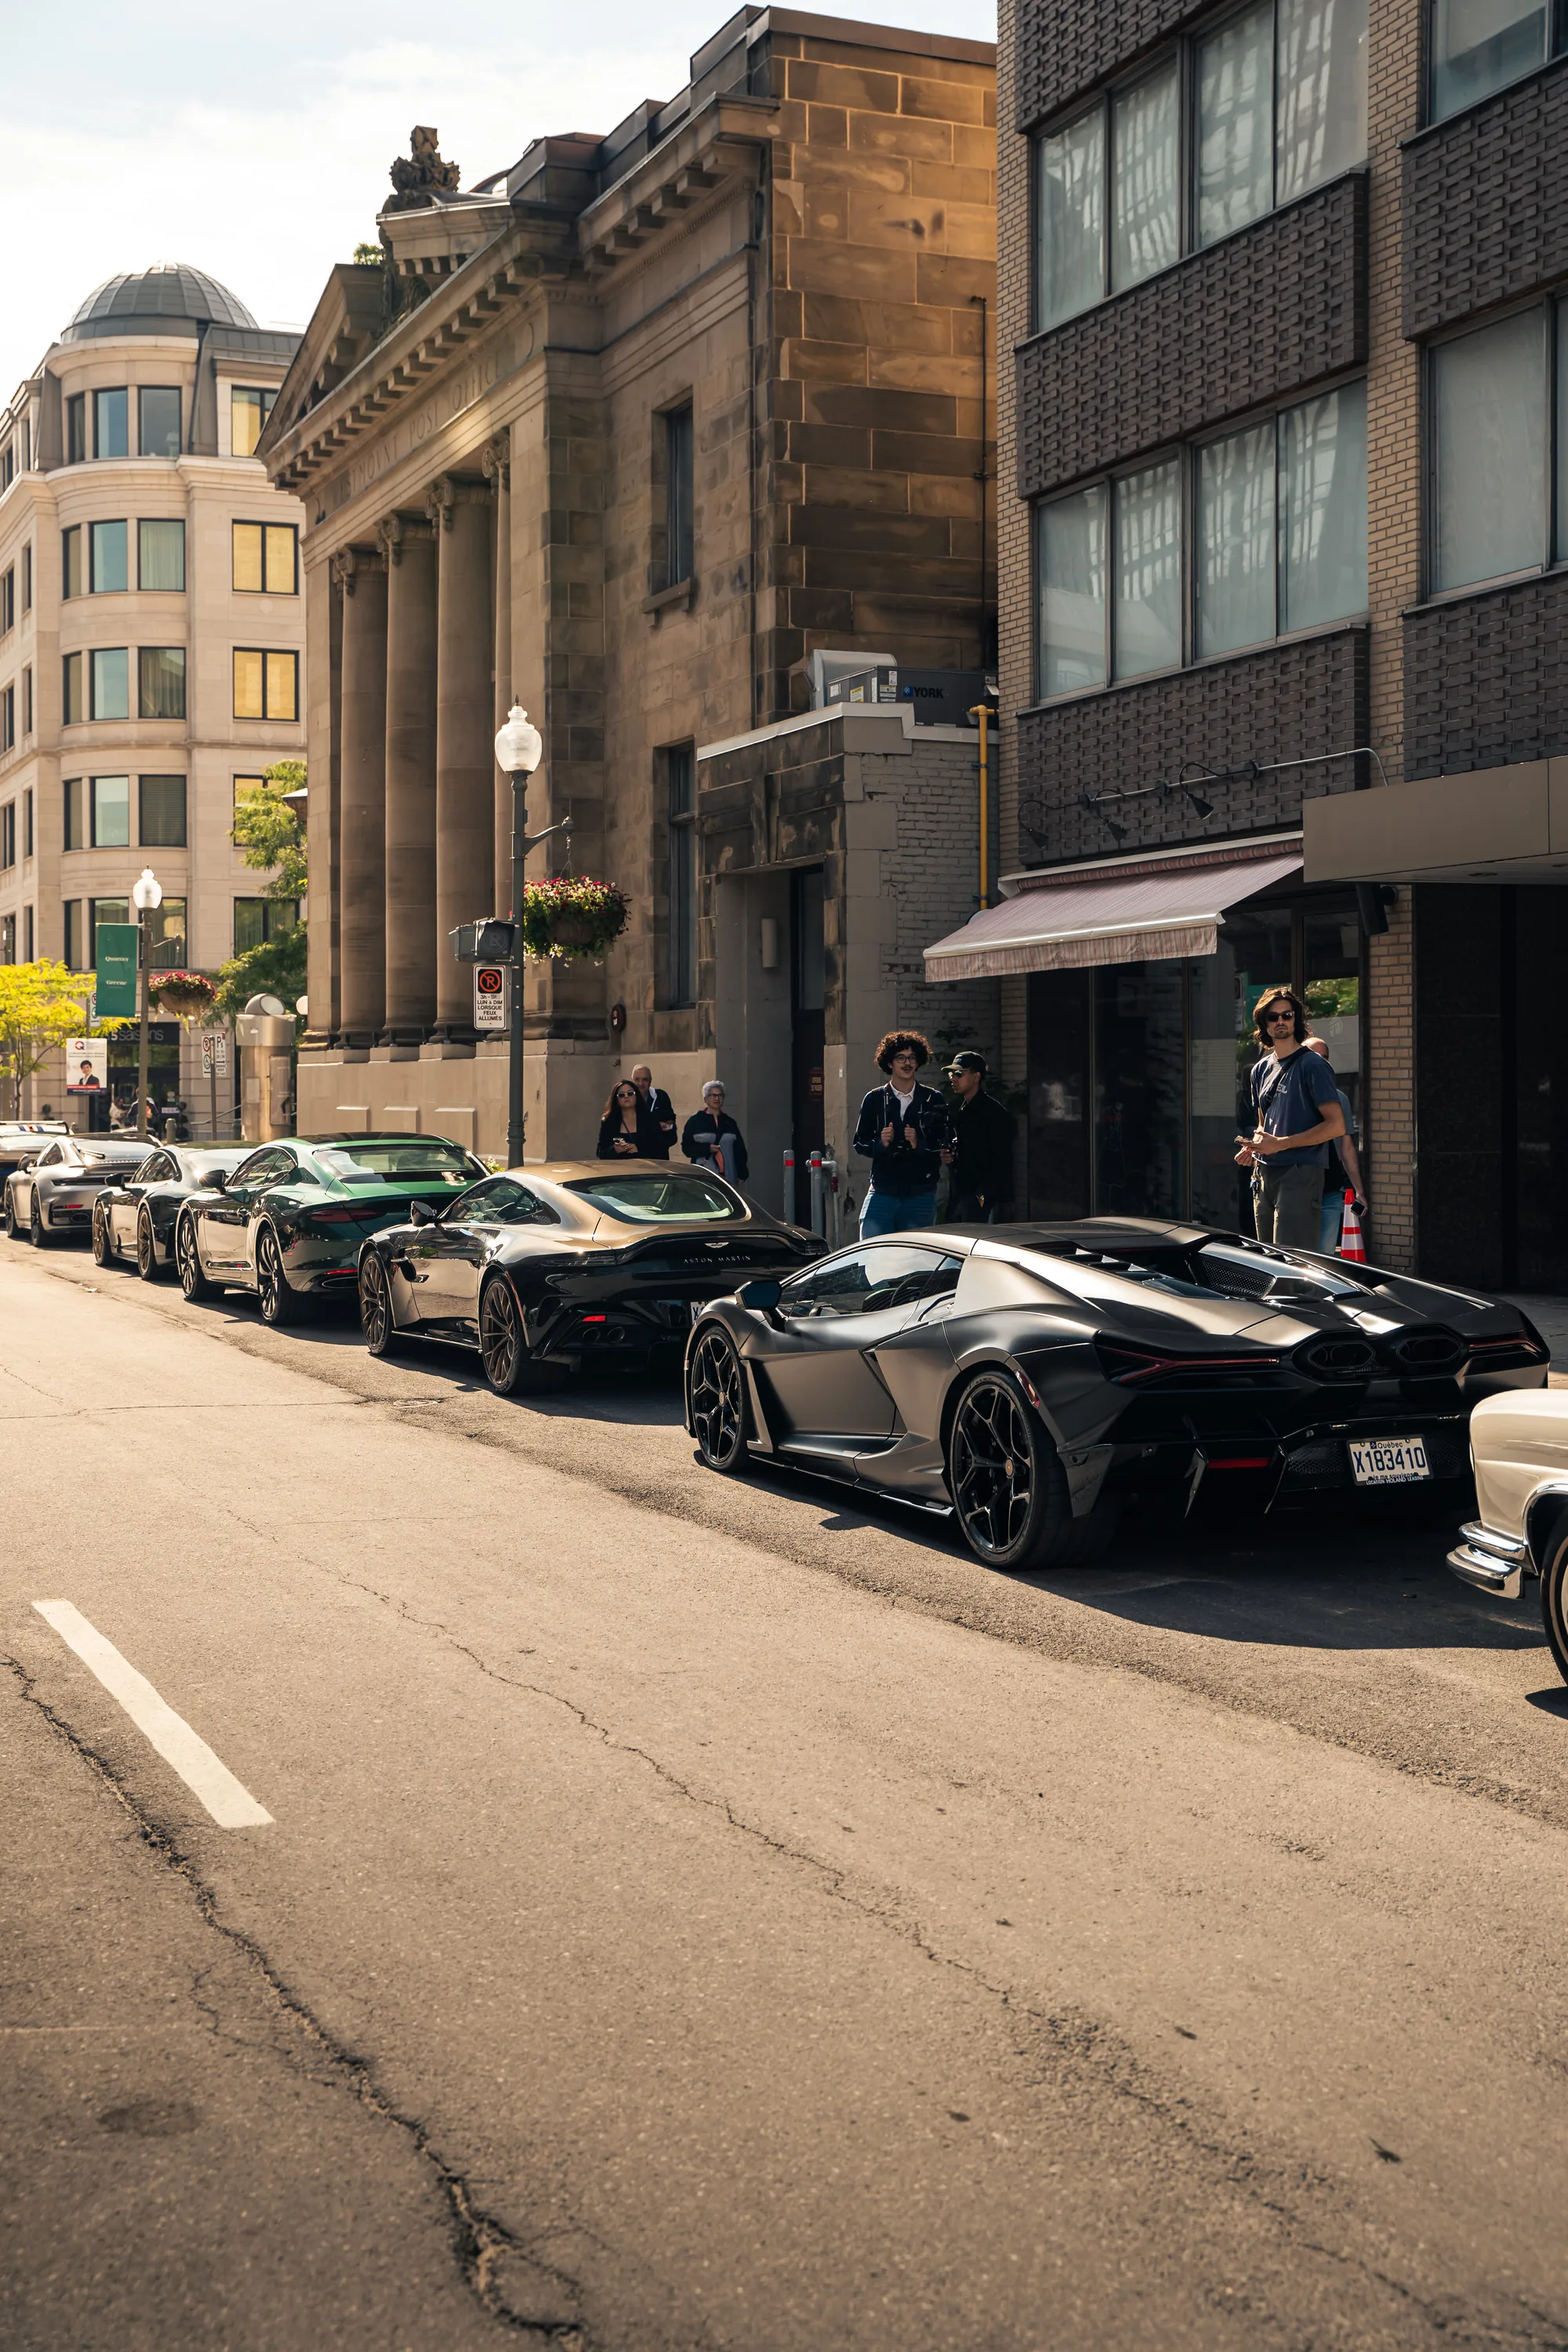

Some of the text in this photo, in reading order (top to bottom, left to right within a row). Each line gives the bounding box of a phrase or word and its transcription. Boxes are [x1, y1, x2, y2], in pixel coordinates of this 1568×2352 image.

[913, 687, 944, 699] YORK
[111, 1031, 118, 1041] 5
[119, 1029, 163, 1041] saisns
[1353, 1447, 1426, 1473] X183410
